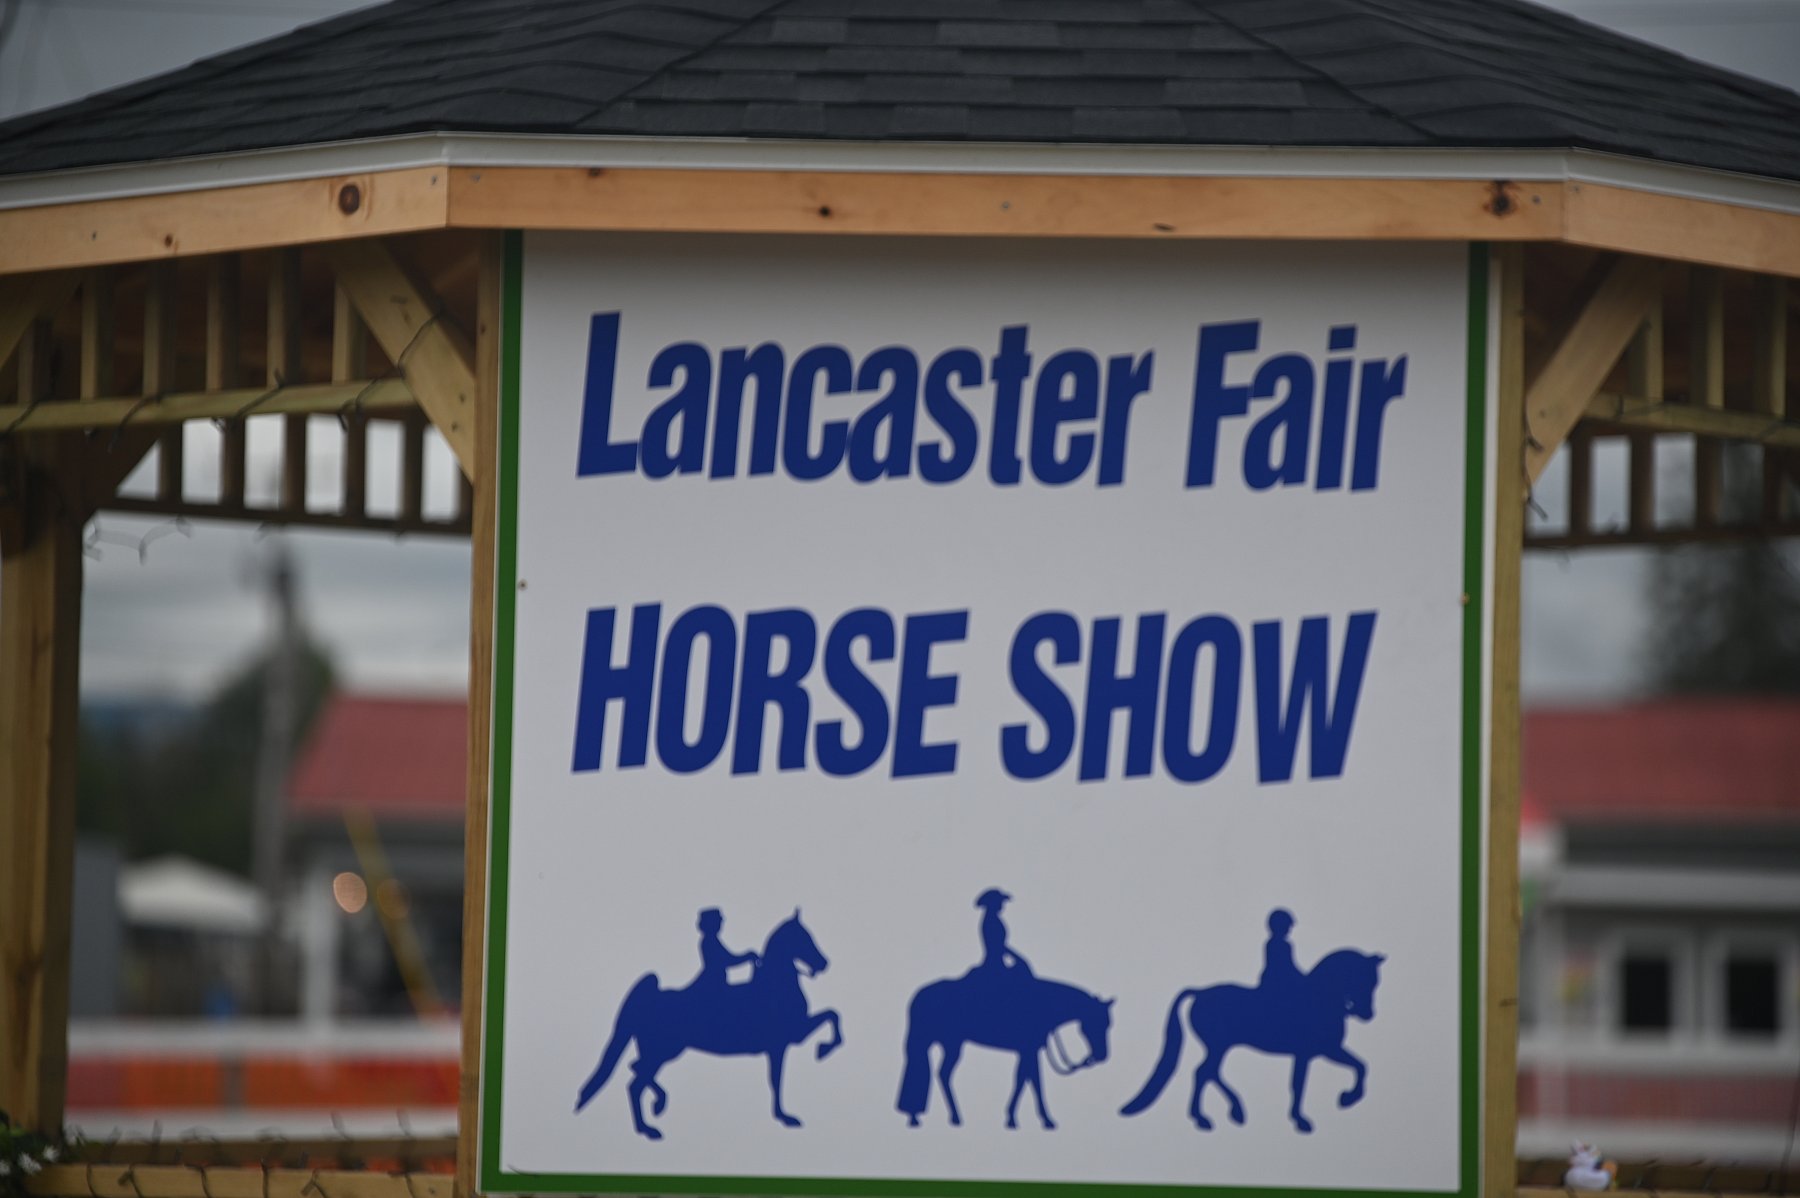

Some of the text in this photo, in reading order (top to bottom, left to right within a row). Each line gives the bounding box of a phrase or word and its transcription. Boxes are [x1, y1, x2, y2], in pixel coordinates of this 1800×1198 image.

[576, 310, 1408, 493] Lancaster Fair
[571, 601, 1378, 785] HORSE SHOW
